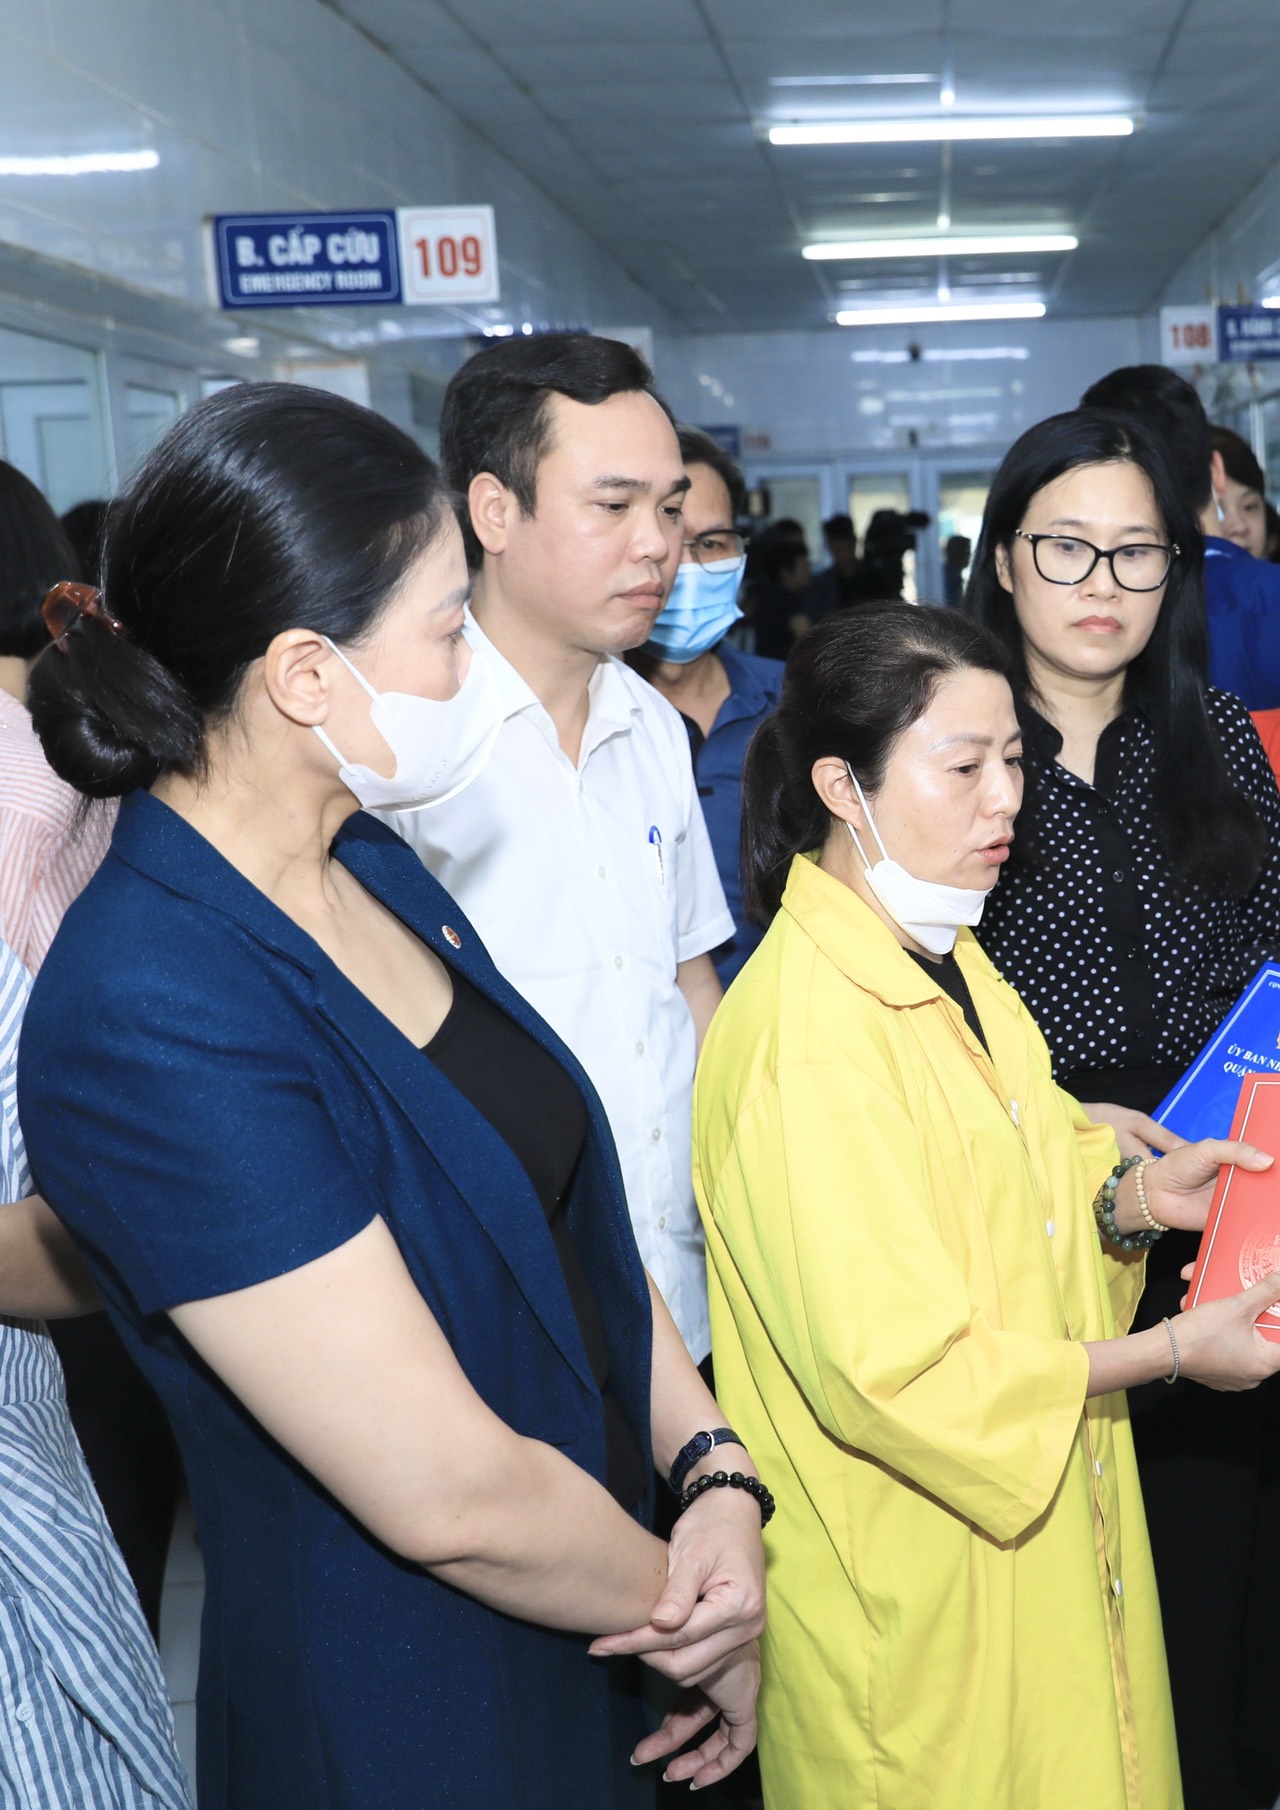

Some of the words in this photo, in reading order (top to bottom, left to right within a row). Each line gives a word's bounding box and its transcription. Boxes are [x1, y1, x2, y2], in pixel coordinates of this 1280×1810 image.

[235, 235, 265, 267] B.
[268, 224, 322, 266] CẤP
[326, 226, 381, 265] CỨU
[415, 234, 483, 280] 109
[239, 269, 333, 294] EMERGENCY
[334, 269, 383, 291] ROOM
[1227, 1043, 1244, 1057] ỦY
[1243, 1050, 1268, 1065] BAN
